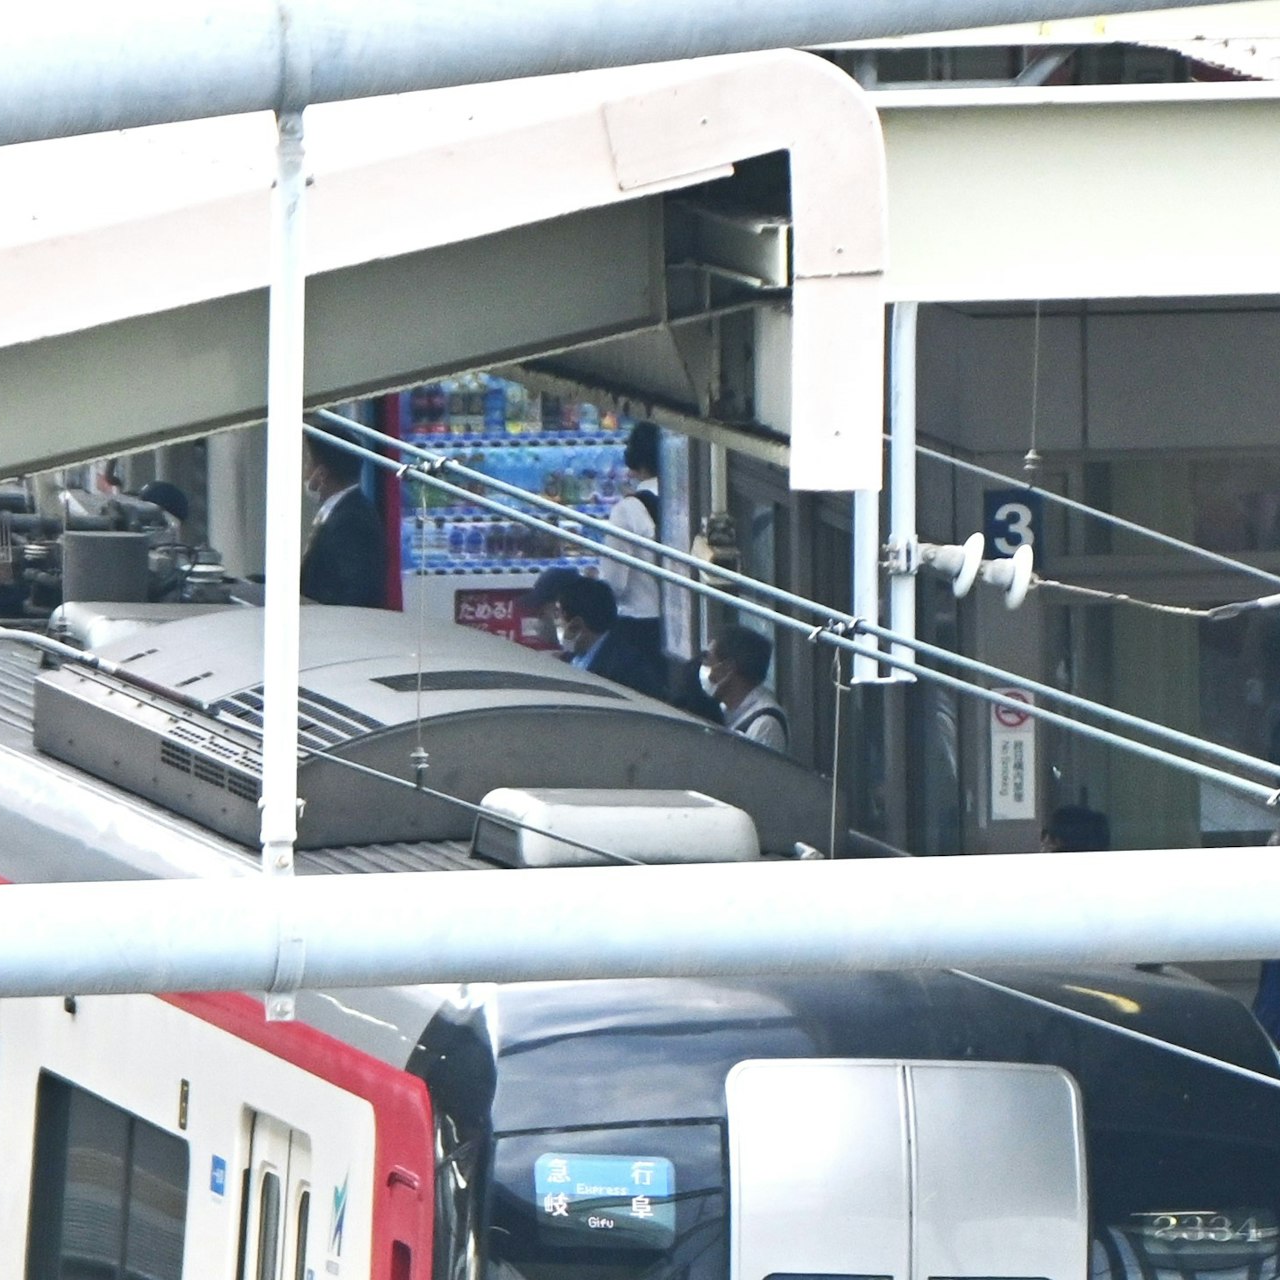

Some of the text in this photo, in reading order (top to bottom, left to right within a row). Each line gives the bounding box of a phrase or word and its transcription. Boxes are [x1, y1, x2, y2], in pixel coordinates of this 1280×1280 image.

[994, 503, 1034, 555] 3
[546, 1158, 656, 1186] 急行
[576, 1183, 629, 1196] Express
[544, 1192, 654, 1219] 岐阜
[587, 1216, 614, 1229] Gifu
[1153, 1215, 1262, 1242] 2334
